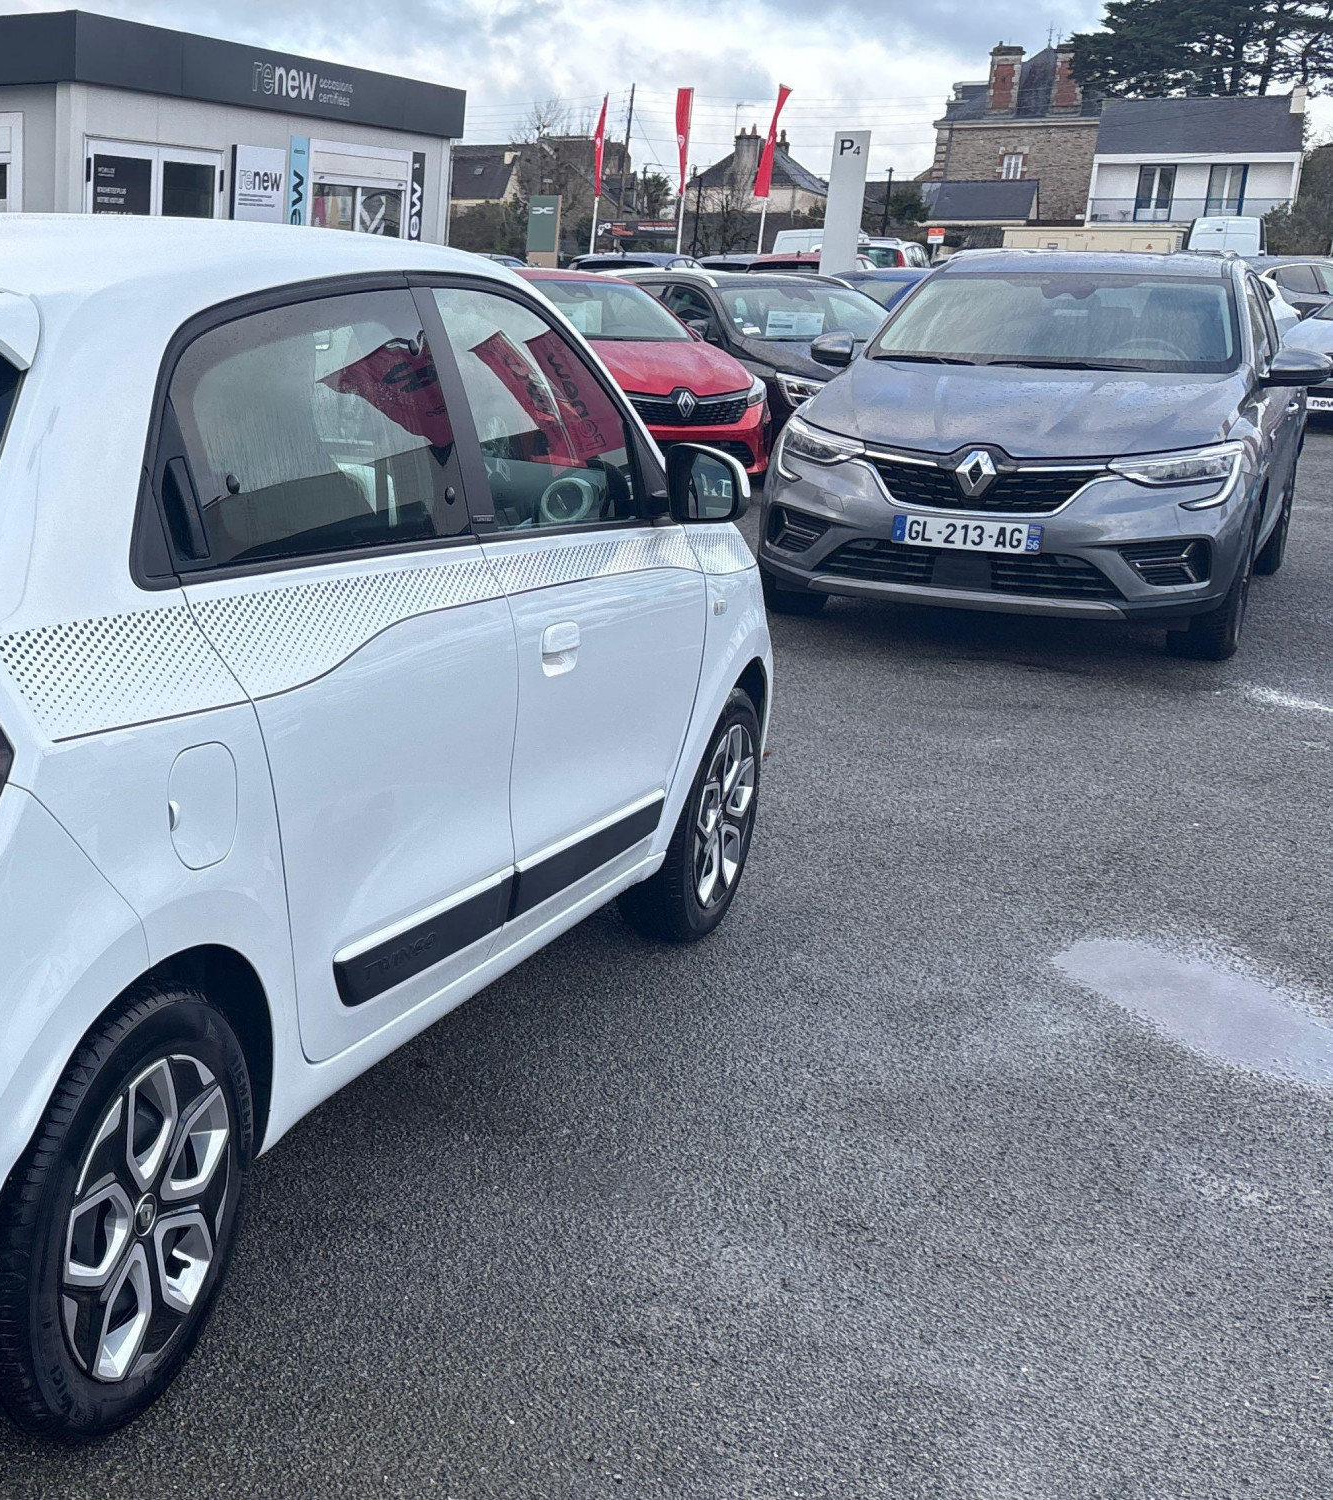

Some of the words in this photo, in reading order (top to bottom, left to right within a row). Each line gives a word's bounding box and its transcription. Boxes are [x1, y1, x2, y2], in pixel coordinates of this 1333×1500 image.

[252, 62, 318, 101] renew
[319, 78, 354, 93] occasions
[238, 169, 282, 191] renew
[908, 519, 1023, 549] GL-213-AG
[1026, 539, 1040, 550] 56
